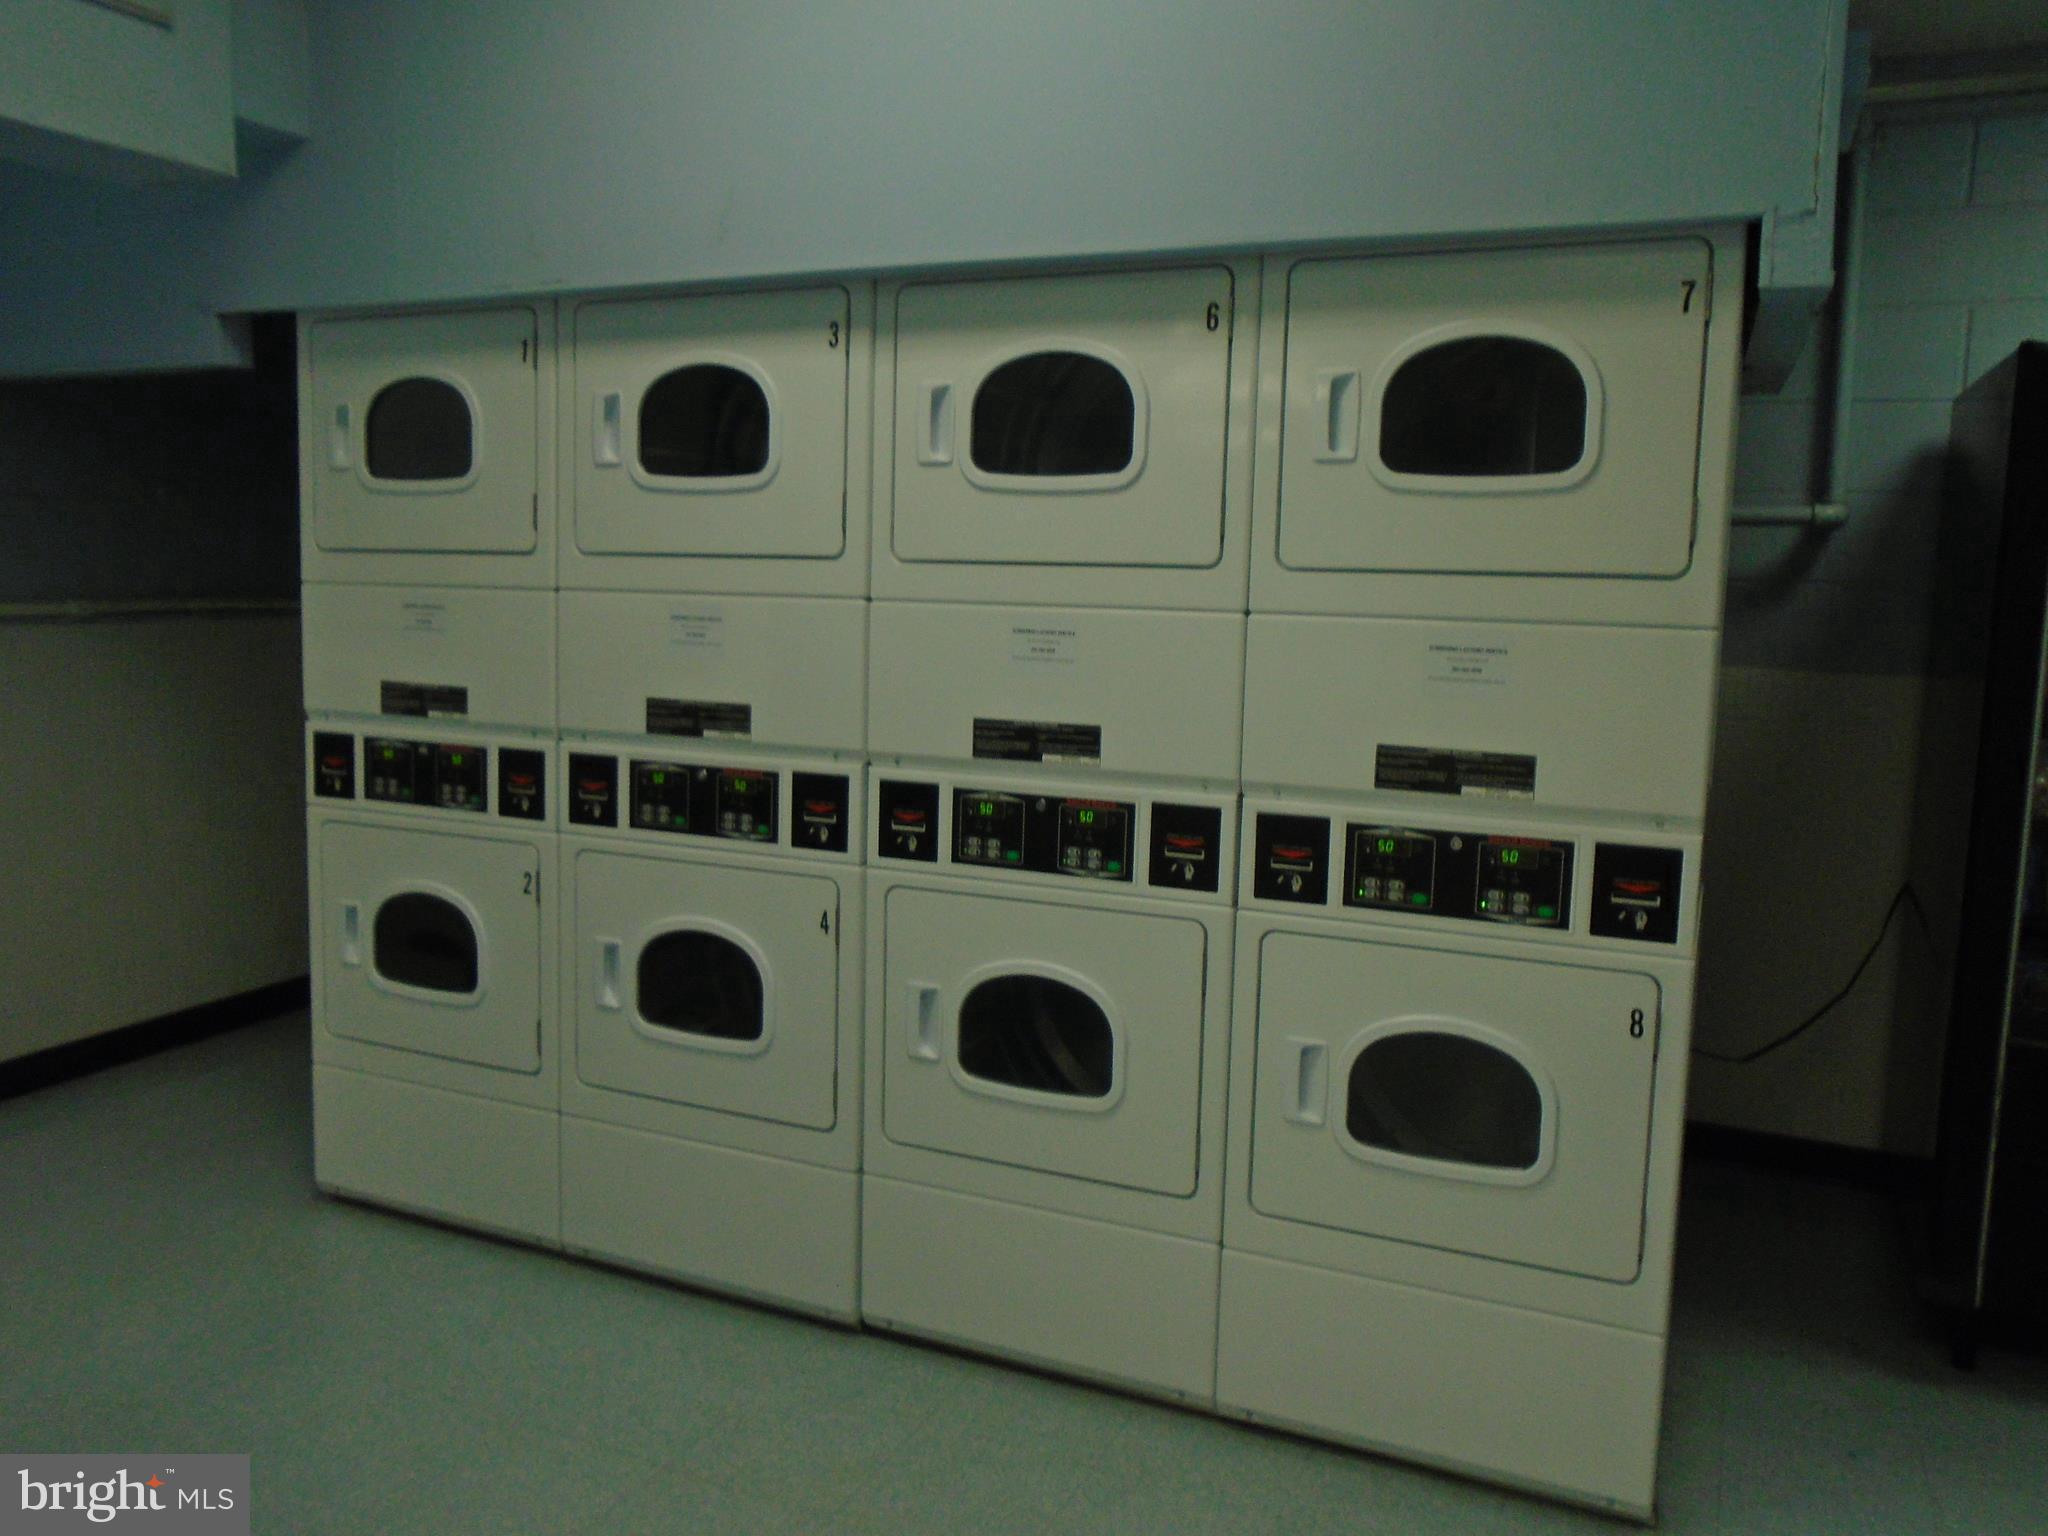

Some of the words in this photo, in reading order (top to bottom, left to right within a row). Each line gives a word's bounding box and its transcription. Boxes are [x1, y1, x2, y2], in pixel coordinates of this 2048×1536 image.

[1682, 281, 1696, 313] 7
[1206, 303, 1220, 331] 6
[829, 322, 840, 348] 3
[522, 338, 529, 363] 1
[523, 872, 532, 895] 2
[819, 911, 830, 935] 4
[1629, 1008, 1644, 1039] 8
